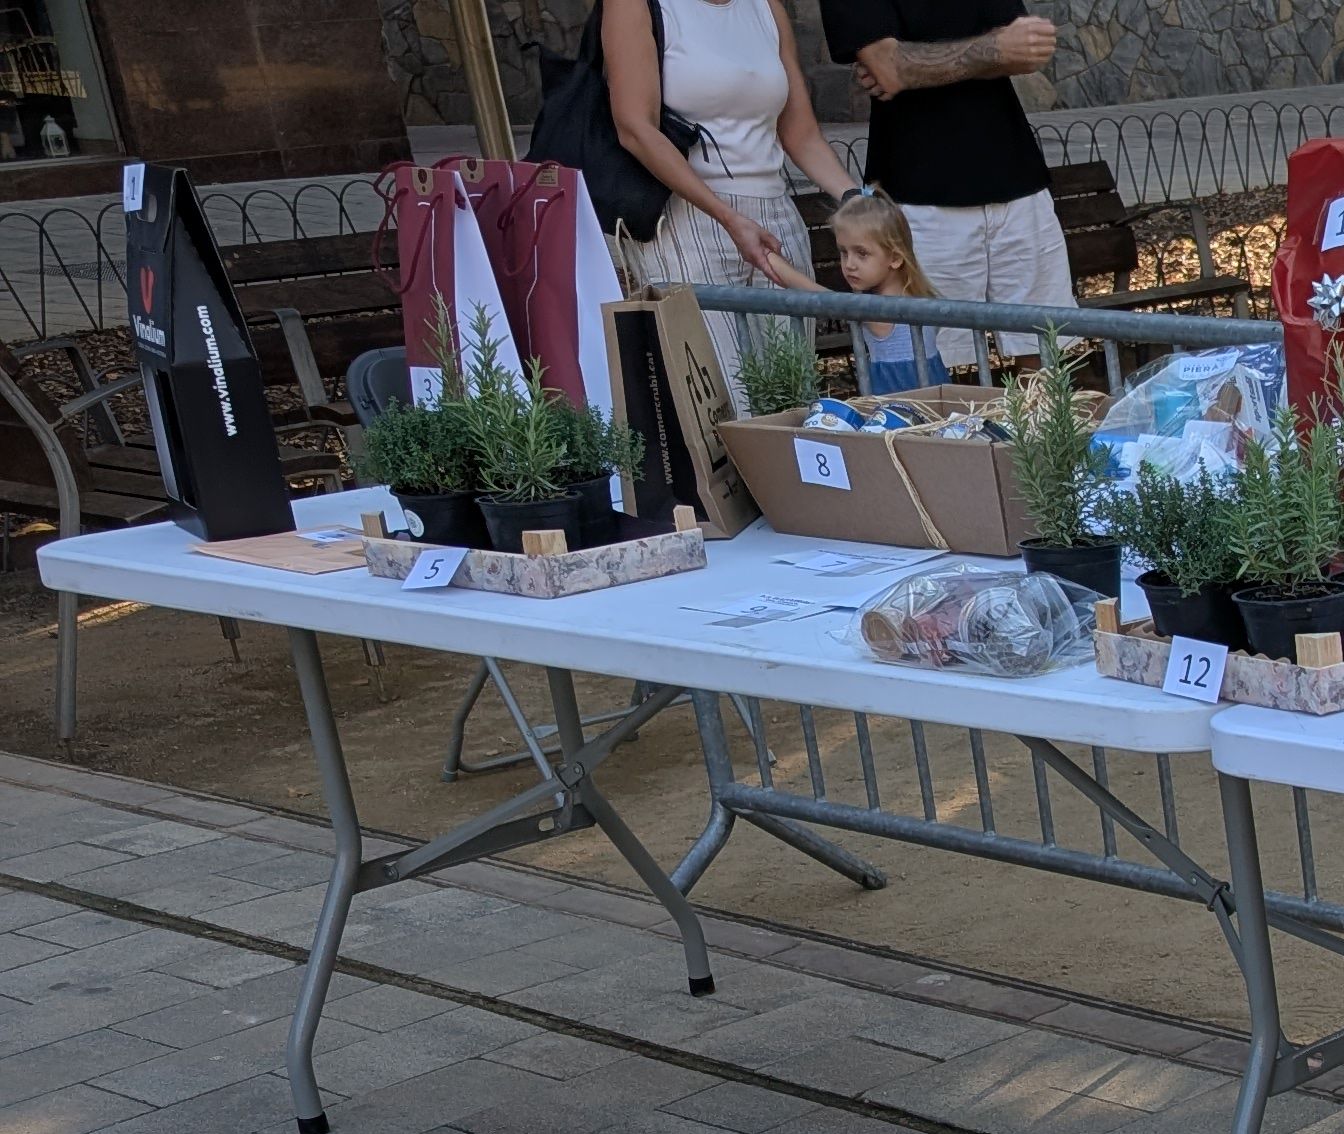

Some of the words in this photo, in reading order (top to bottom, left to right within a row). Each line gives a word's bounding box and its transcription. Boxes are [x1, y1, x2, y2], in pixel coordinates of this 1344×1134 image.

[196, 305, 238, 438] www.vinalium.com
[424, 378, 434, 402] 3
[815, 453, 831, 477] 8
[424, 558, 444, 580] 5
[1179, 654, 1211, 688] 12
